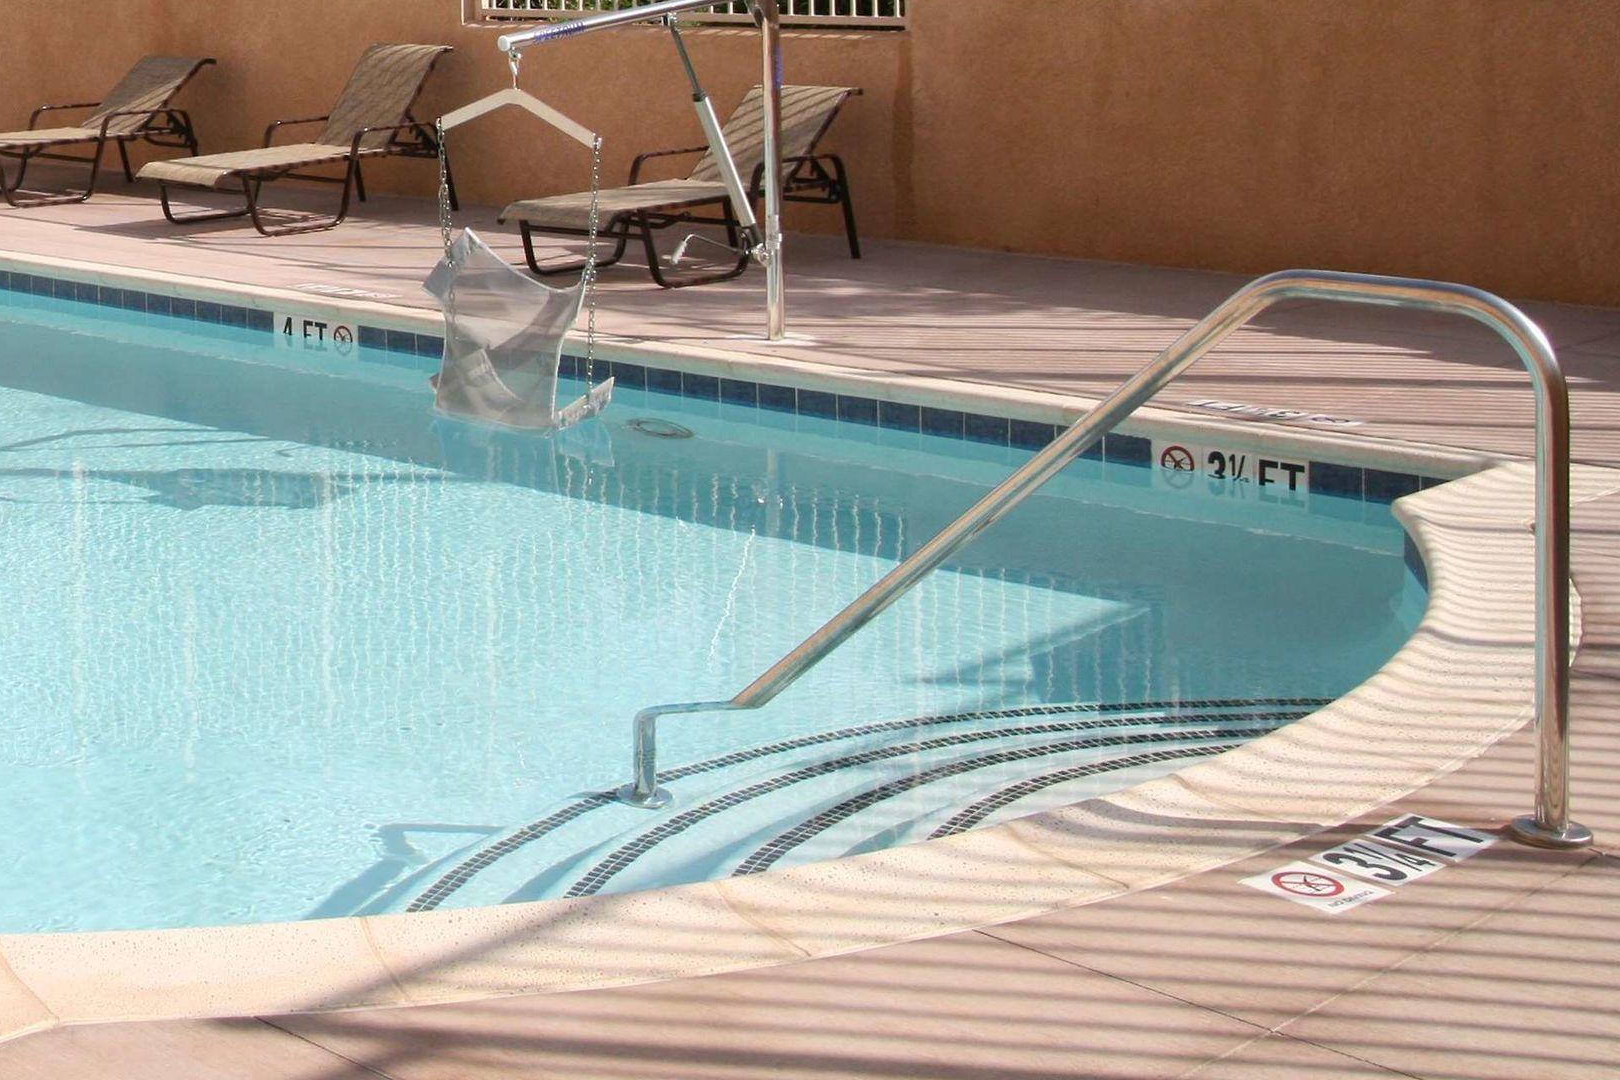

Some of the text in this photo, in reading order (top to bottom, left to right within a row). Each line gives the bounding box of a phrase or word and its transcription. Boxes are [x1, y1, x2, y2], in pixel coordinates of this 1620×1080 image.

[303, 319, 328, 341] FT
[1258, 458, 1306, 492] FT
[1374, 815, 1484, 858] FT
